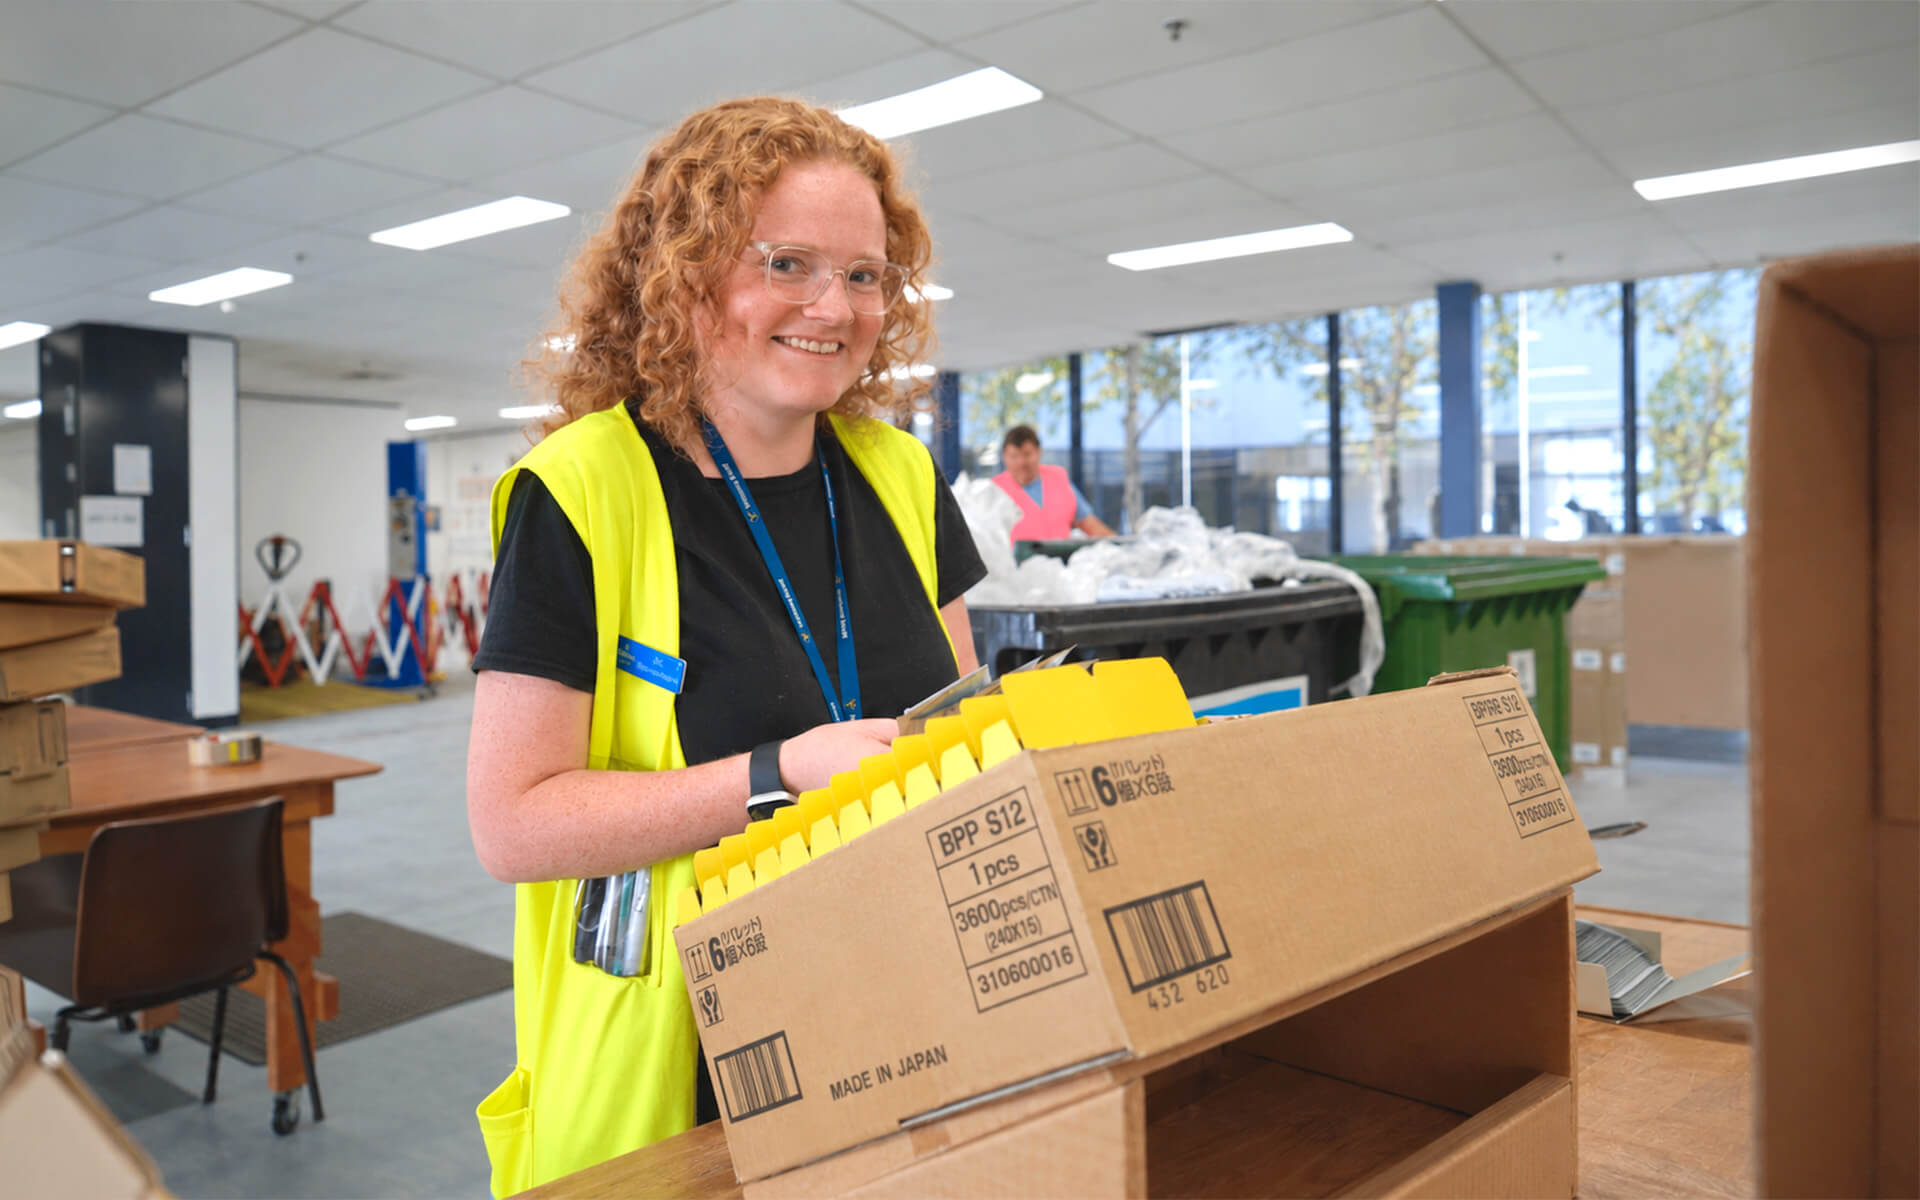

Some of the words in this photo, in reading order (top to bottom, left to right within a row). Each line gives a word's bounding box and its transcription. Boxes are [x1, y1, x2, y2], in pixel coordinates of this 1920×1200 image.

[1495, 727, 1505, 746] 1
[1504, 728, 1525, 748] pcs
[938, 820, 979, 857] BPP
[985, 800, 1026, 836] S12
[969, 861, 981, 885] 1
[984, 854, 1020, 885] pcs
[955, 882, 1059, 933] 3600pcs/CTN
[977, 945, 1075, 994] 310600016
[1147, 982, 1184, 1011] 432
[1196, 964, 1229, 994] 620
[829, 1070, 873, 1101] MADE
[876, 1063, 893, 1084] IN
[898, 1044, 948, 1077] JAPAN
